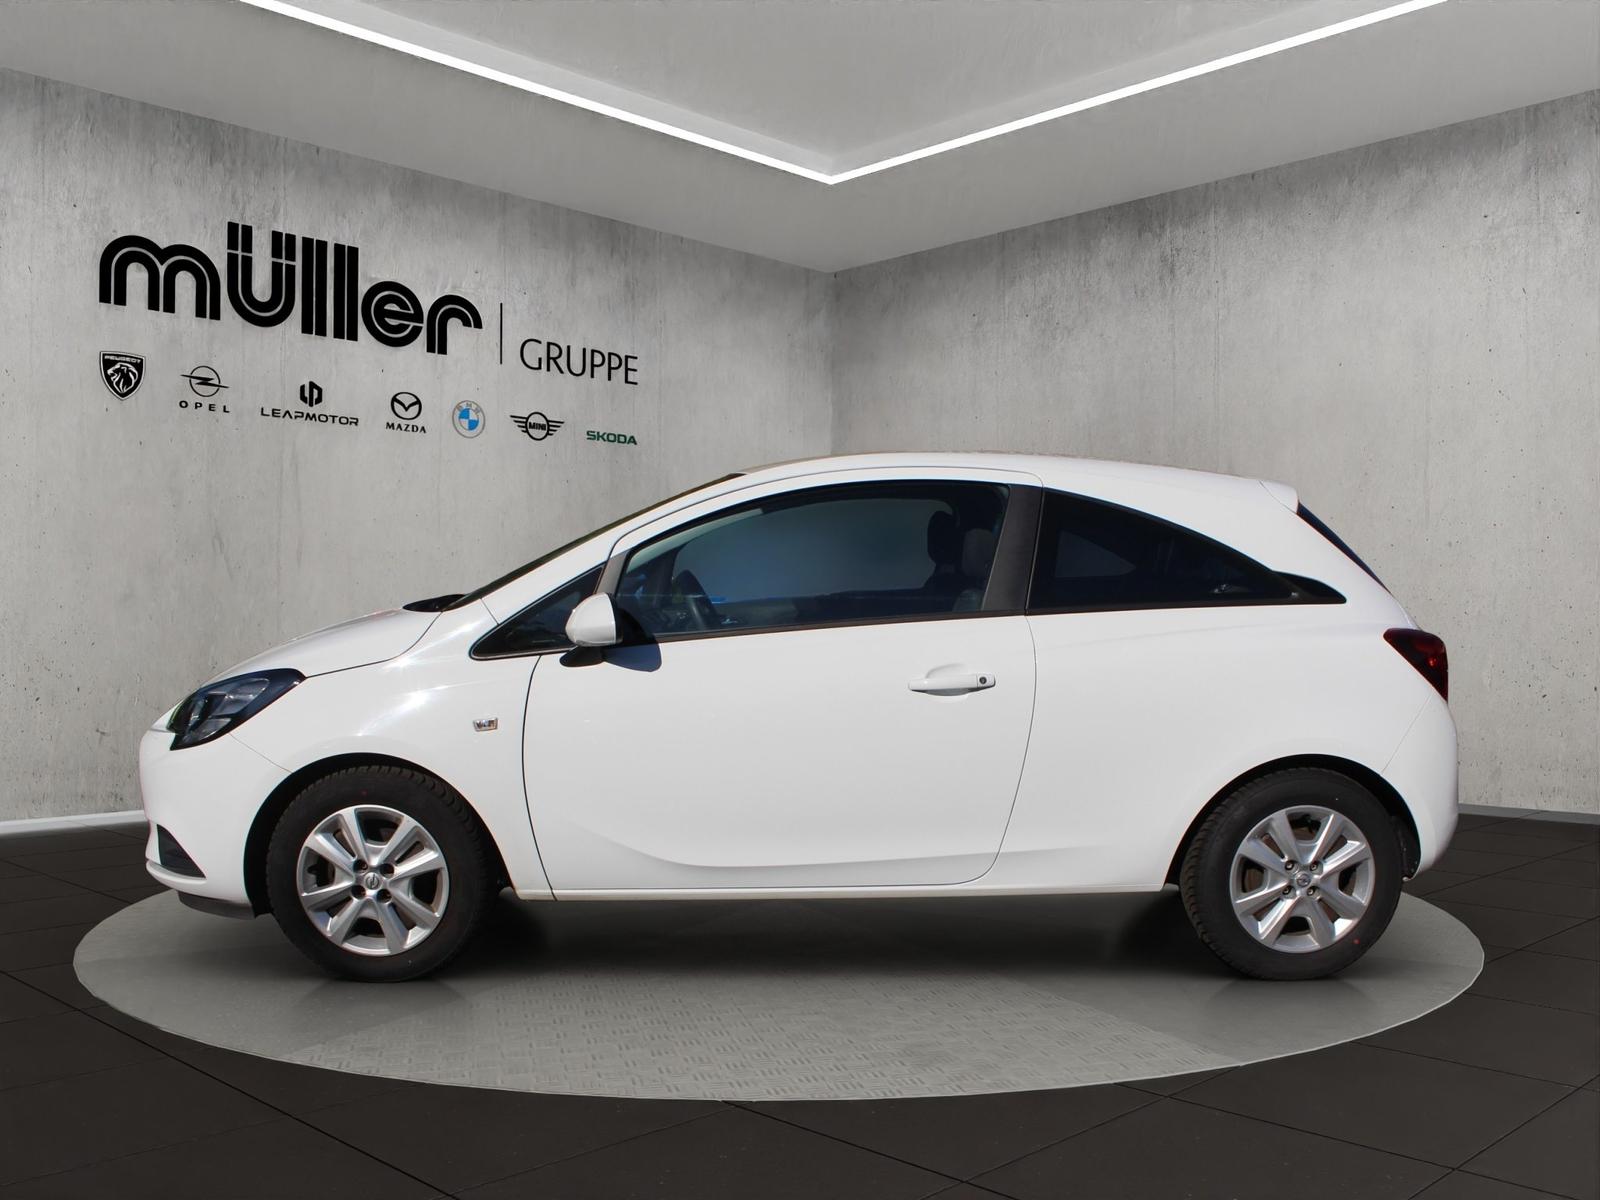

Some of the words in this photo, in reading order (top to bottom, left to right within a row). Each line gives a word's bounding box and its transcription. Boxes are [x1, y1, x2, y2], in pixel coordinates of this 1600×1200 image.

[519, 338, 639, 386] GRUPPE
[178, 400, 231, 414] OPEL
[260, 406, 360, 427] LEAPMOTOR
[385, 421, 428, 434] MAZDA
[528, 421, 547, 432] MINI
[586, 430, 638, 446] SKODA
